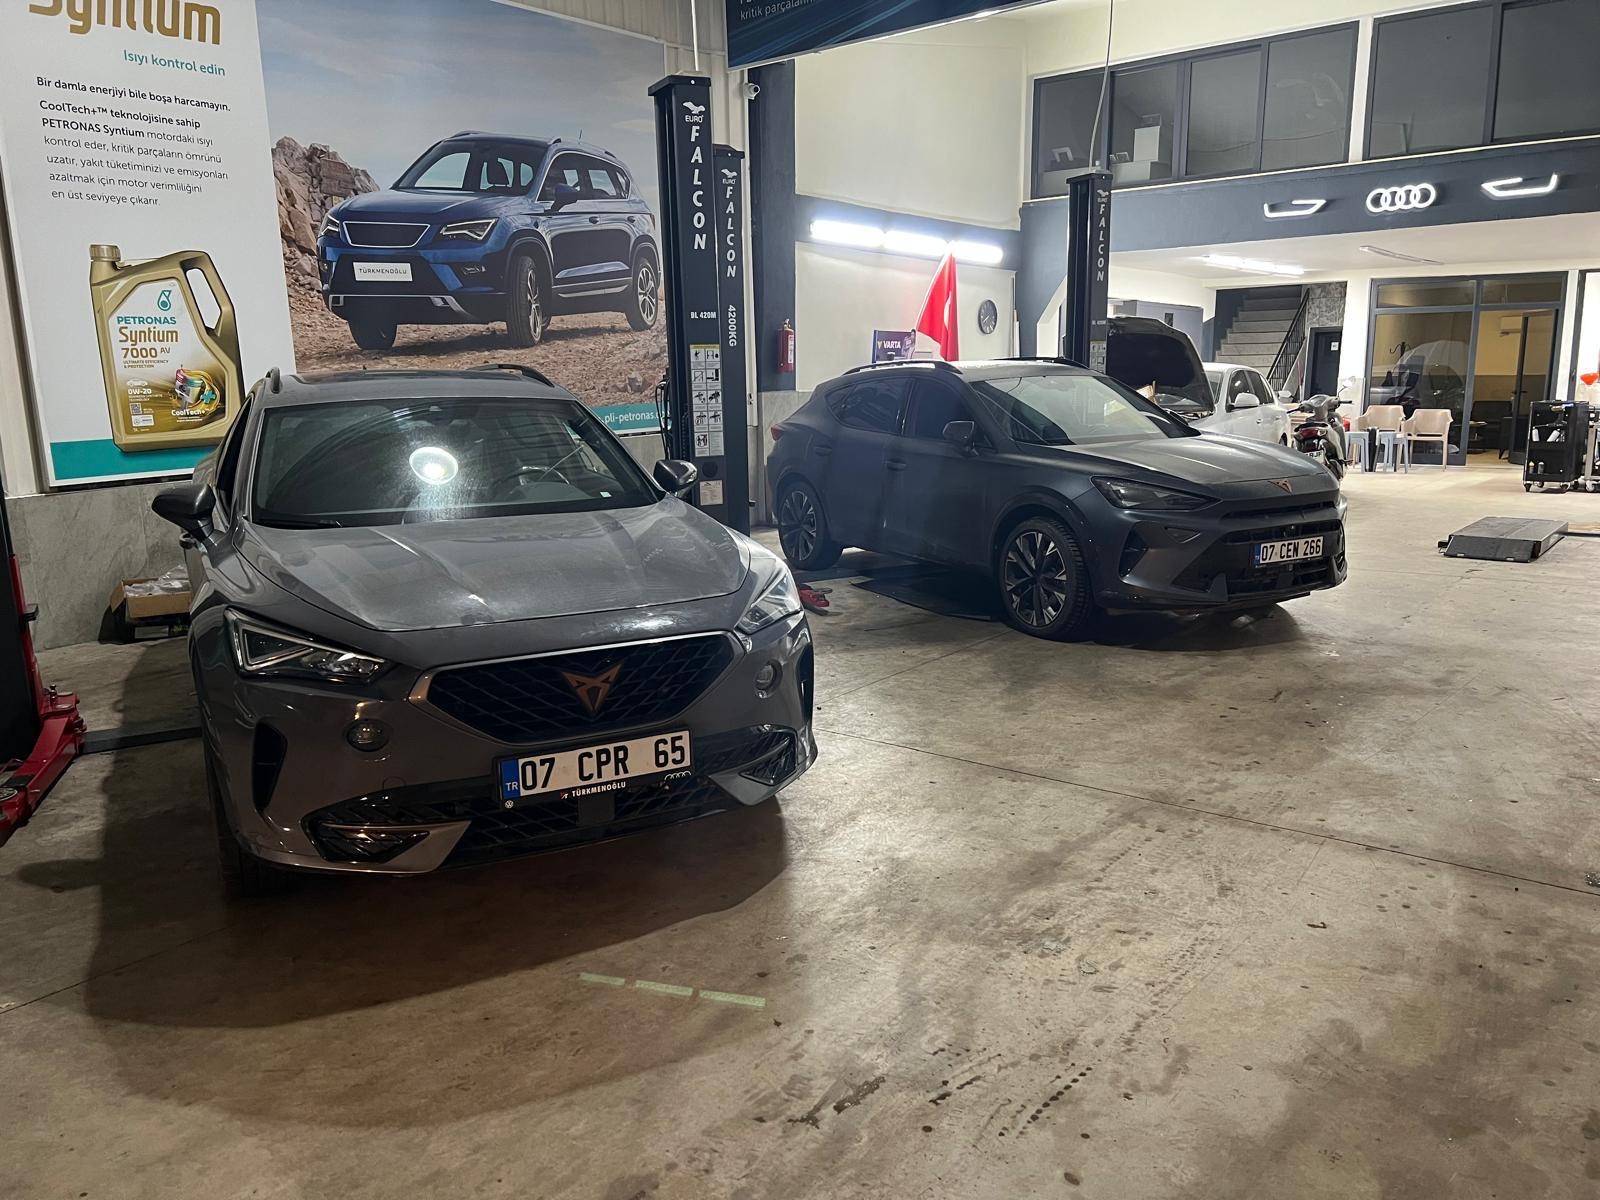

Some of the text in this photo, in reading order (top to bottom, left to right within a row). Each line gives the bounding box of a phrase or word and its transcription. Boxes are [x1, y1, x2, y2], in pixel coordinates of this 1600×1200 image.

[741, 6, 762, 20] kritik
[151, 54, 197, 72] kontrol
[199, 62, 226, 76] edin
[37, 76, 231, 111] Bir damla enerjiyi bile boşa harcamayın.
[42, 118, 101, 133] PETRONAS
[103, 124, 145, 138] Syntium
[147, 131, 195, 143] motordaki
[110, 109, 173, 125] teknolojisine
[176, 118, 201, 130] sahip
[44, 136, 222, 163] kontrol eder, kritik parçaların ömrünü
[47, 155, 229, 180] uzatır, yakıt tüketiminizi ve emisyonları
[49, 173, 202, 194] azaltmak için motor verimliliğini
[690, 125, 707, 250] FALCON
[51, 190, 65, 198] en
[67, 189, 83, 200] üst
[85, 193, 127, 204] seviyeye
[725, 186, 737, 278] FALCON
[1096, 204, 1106, 281] FALCON
[117, 316, 177, 325] PETRONAS
[700, 311, 717, 319] 420M
[728, 304, 737, 347] 4200KG
[118, 326, 179, 346] Syntium
[883, 340, 901, 349] VARTA
[121, 347, 158, 359] 7000
[1261, 538, 1321, 561] 07 CEN 266
[506, 735, 685, 791] TR 07 CPR 65
[572, 781, 626, 798] TÜRKMENOĞLU
